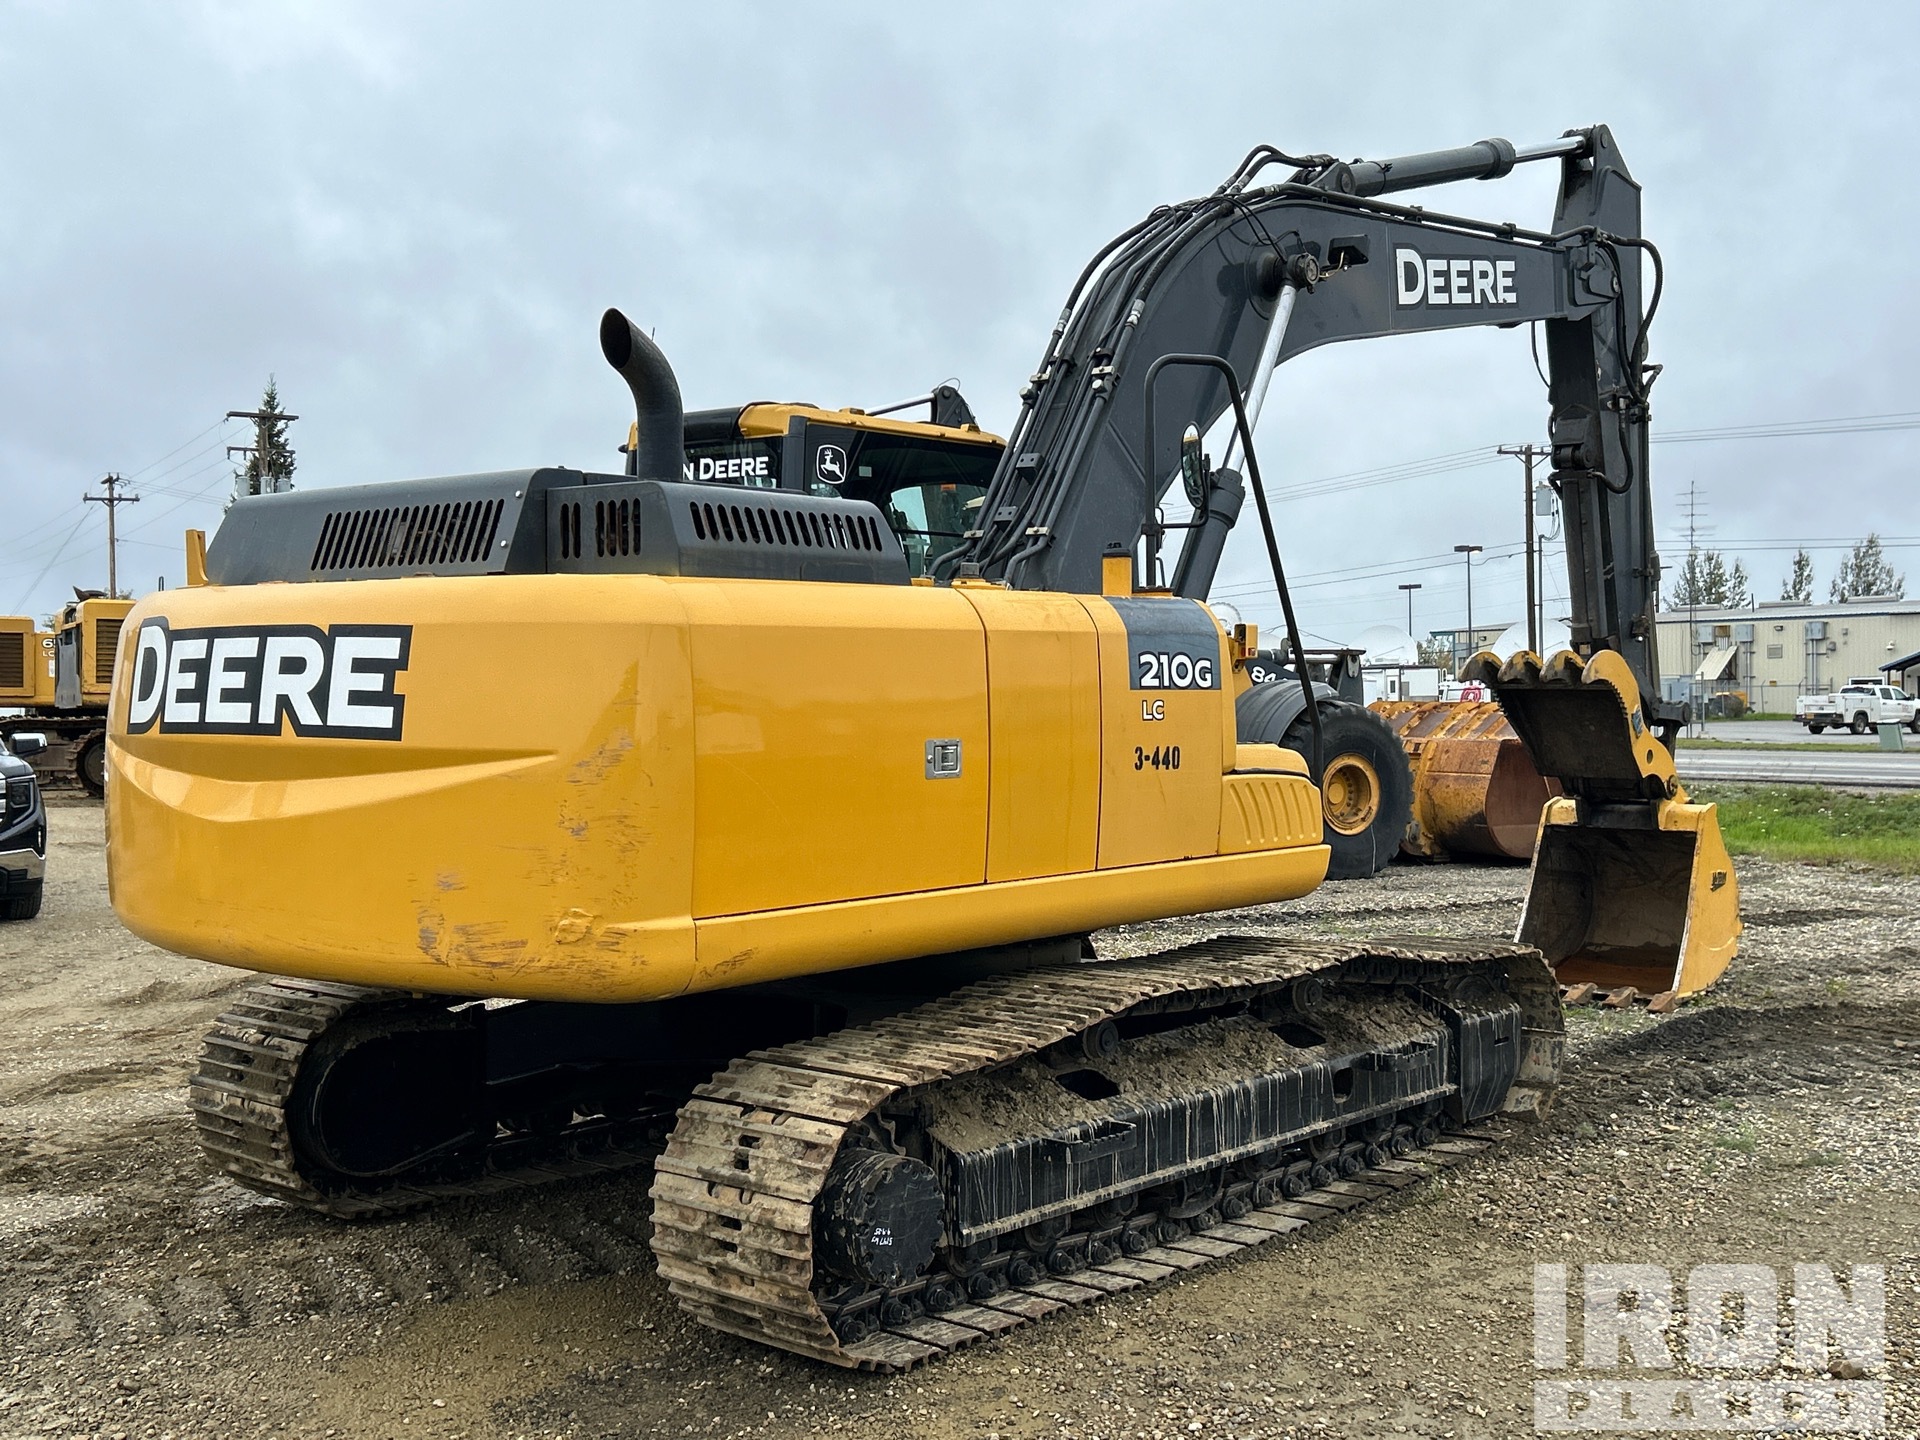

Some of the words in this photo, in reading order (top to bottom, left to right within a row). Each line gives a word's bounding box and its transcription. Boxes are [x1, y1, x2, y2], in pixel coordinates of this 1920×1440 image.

[1395, 248, 1517, 305] DEERE
[699, 455, 769, 480] DEERE
[129, 624, 402, 729] DEERE
[1139, 653, 1212, 688] 210G
[1142, 701, 1164, 720] LC
[1134, 746, 1180, 770] 3-440
